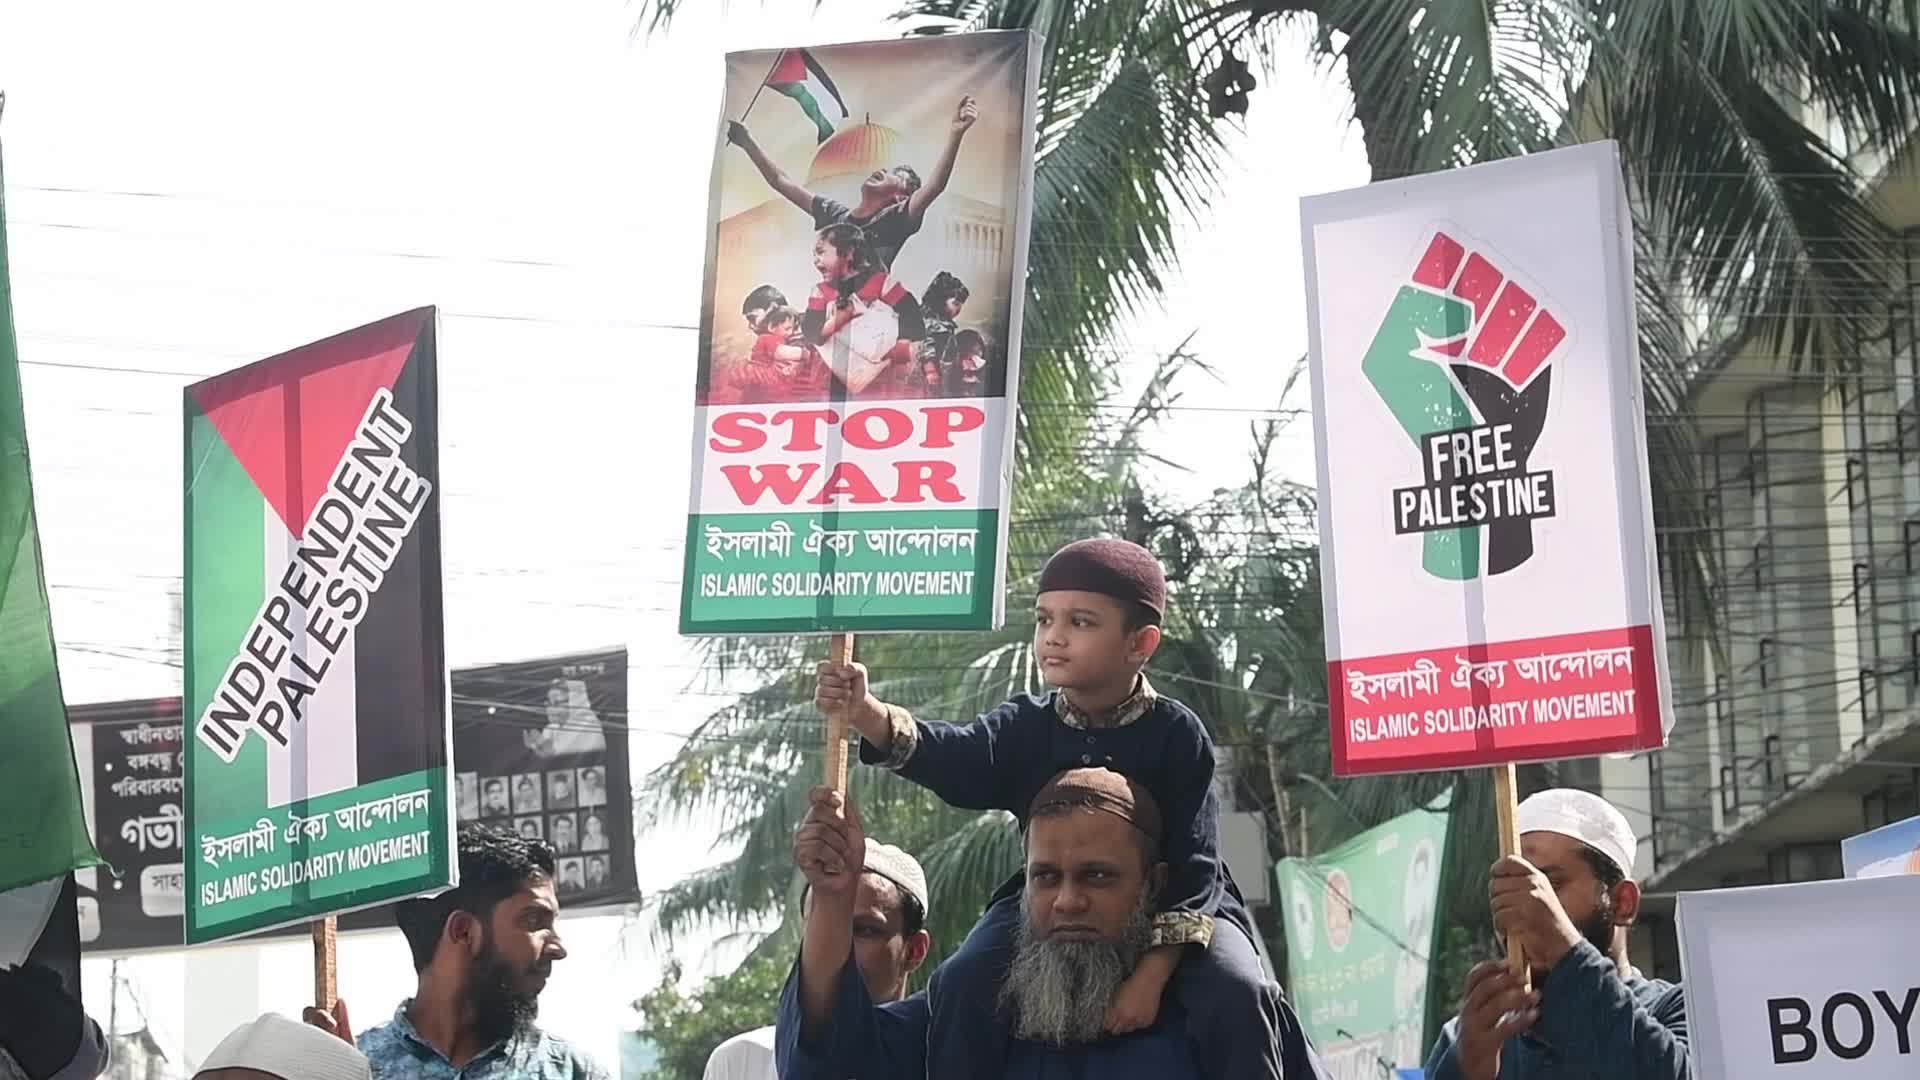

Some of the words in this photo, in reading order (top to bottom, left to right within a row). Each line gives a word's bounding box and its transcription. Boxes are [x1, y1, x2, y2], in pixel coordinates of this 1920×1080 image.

[709, 406, 985, 453] STOP
[1430, 424, 1516, 481] FREE
[719, 460, 967, 505] WAR
[1400, 474, 1550, 529] PALESTINE
[704, 520, 795, 561] ইসলামী
[802, 519, 859, 557] ঐক্য
[864, 525, 979, 556] আন্দোলন
[202, 395, 409, 754] INDEPENDENT
[701, 572, 767, 597] ISLAMIC
[772, 571, 872, 597] SOLIDARITY
[876, 571, 975, 596] MOVEMENT
[257, 466, 426, 745] PALESTINE
[1347, 657, 1442, 705] ইসলামী
[1450, 653, 1508, 691] ঐক্য
[1514, 646, 1635, 684] আন্দোলন
[1350, 711, 1420, 743] ISLAMIC
[1424, 701, 1529, 735] SOLIDARITY
[1533, 689, 1636, 724] MOVEMENT
[121, 803, 183, 852] গভী
[201, 817, 277, 869] ইসলামী
[284, 809, 331, 845] ঐক্য
[335, 788, 432, 833] আন্দোলন
[202, 871, 257, 906] ISLAMIC
[261, 850, 345, 891] SOLIDARITY
[348, 830, 431, 871] MOVEMENT
[1767, 987, 1920, 1064] BOY
